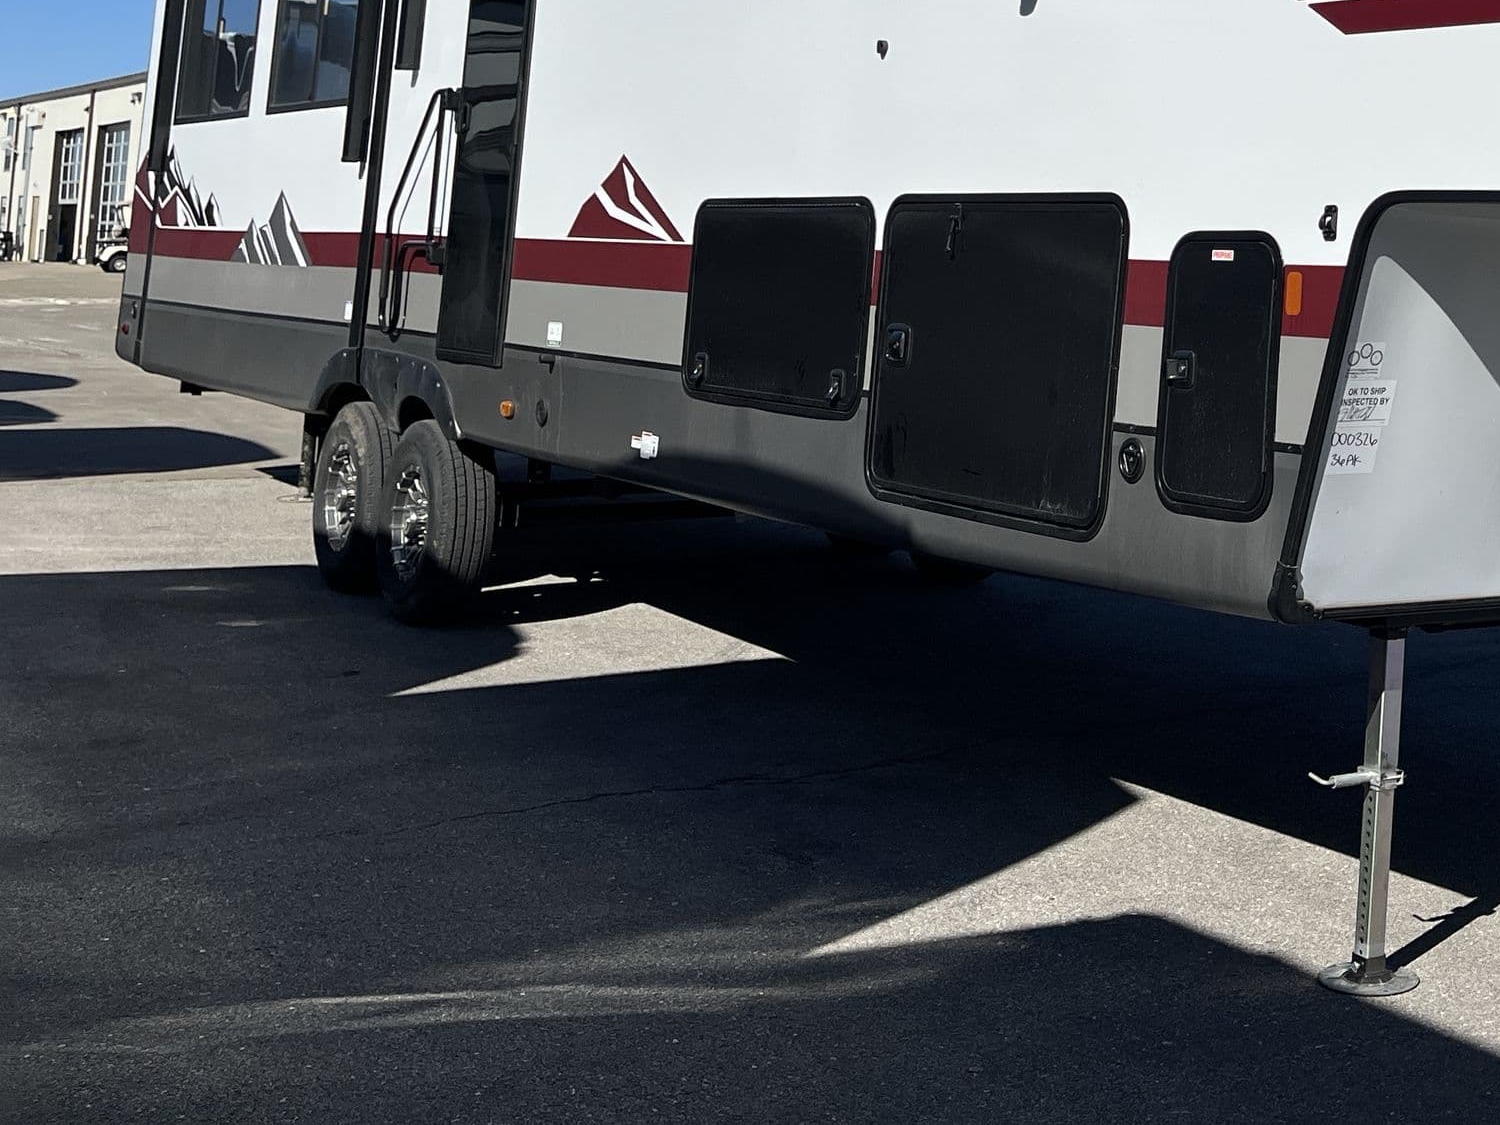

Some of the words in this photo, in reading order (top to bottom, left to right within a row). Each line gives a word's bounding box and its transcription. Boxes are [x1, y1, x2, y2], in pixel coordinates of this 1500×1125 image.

[1348, 388, 1358, 396] OK
[1360, 387, 1369, 395] TO
[1370, 386, 1387, 395] SHIP
[1379, 397, 1390, 405] BY
